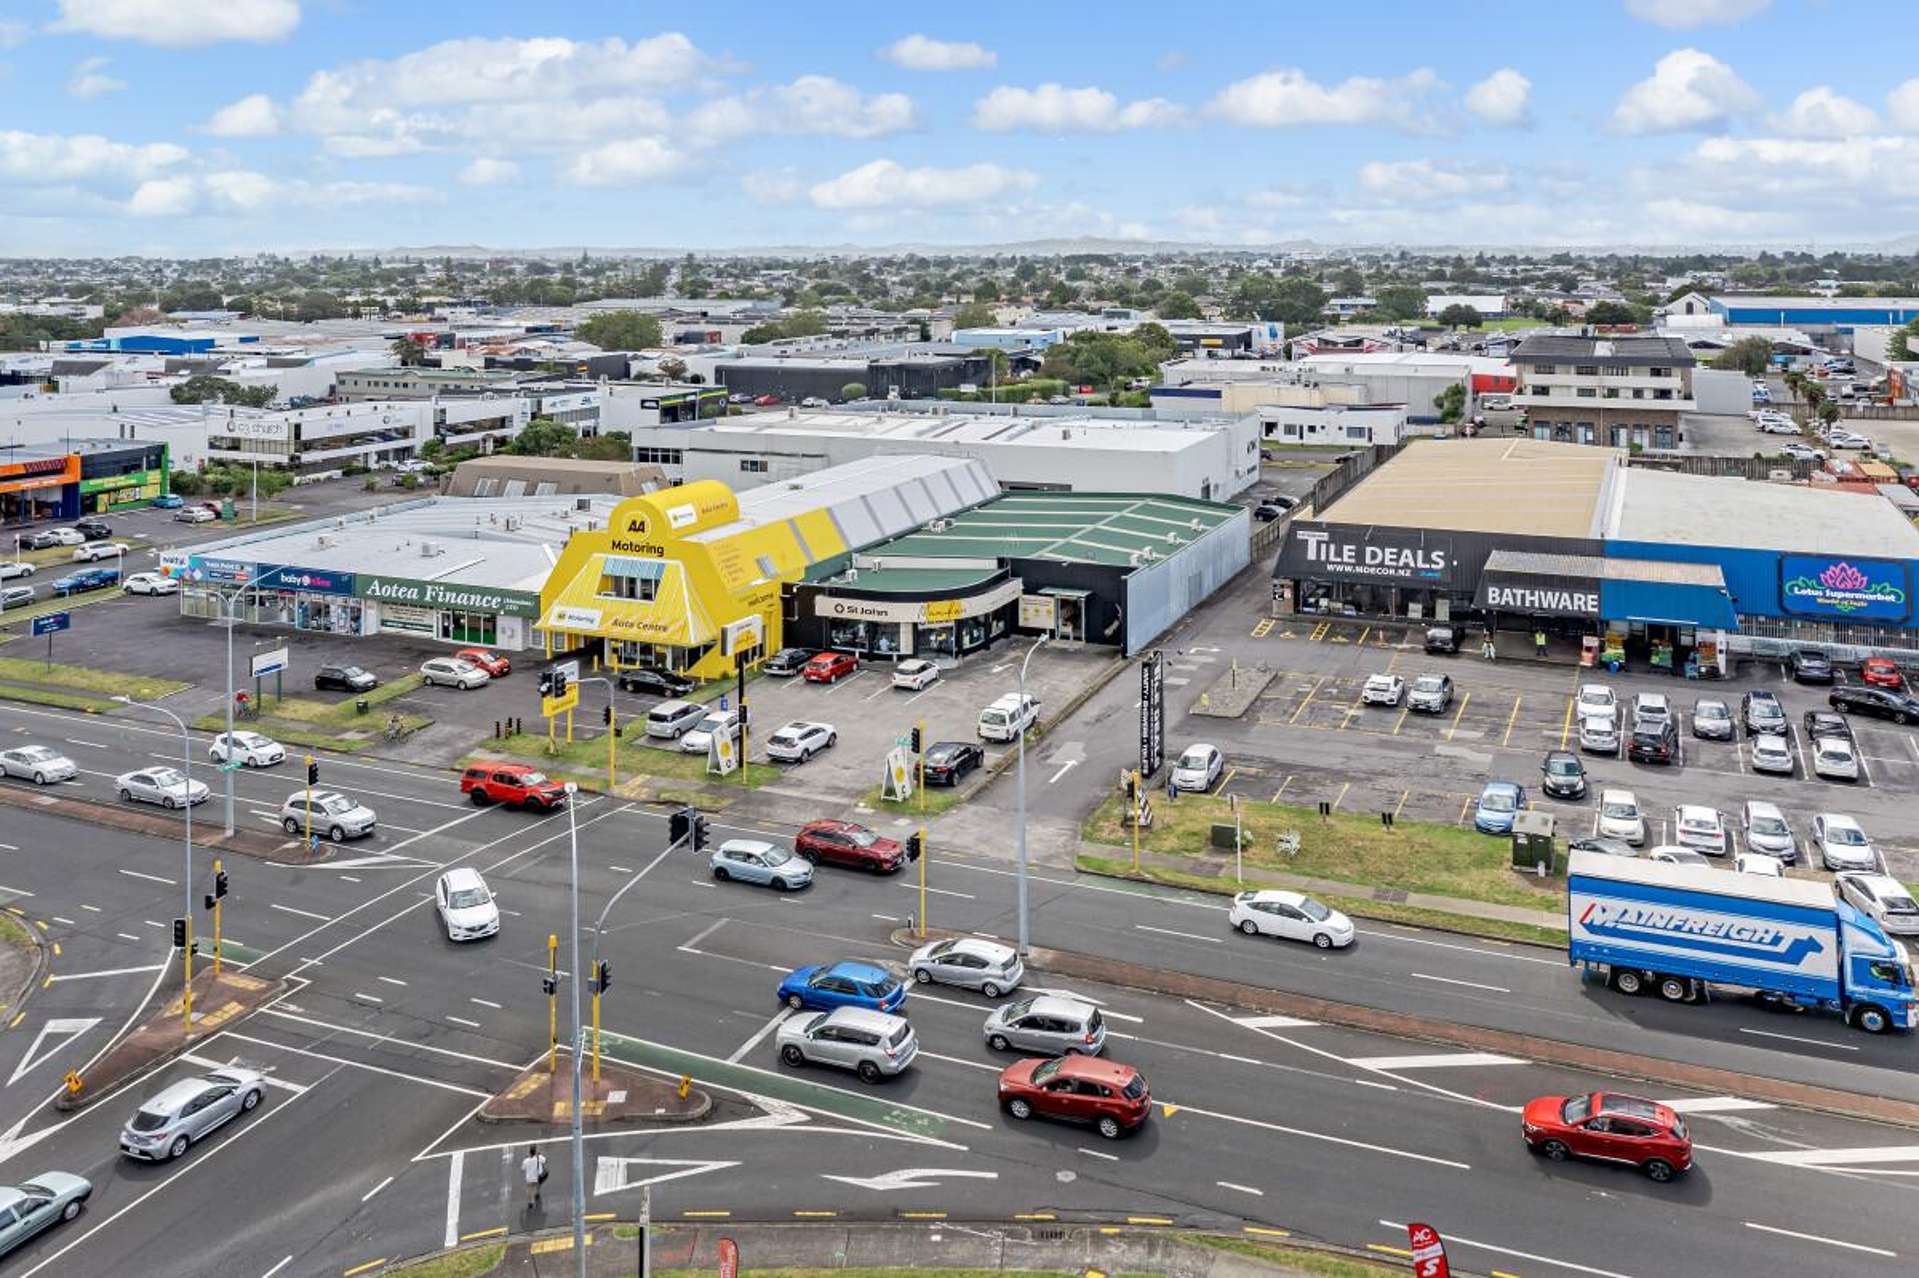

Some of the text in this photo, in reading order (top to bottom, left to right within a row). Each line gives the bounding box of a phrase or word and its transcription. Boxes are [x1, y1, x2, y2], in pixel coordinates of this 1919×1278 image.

[627, 519, 646, 533] AA
[611, 540, 665, 557] Motoring
[1296, 530, 1446, 570] TILE DEALS
[281, 573, 301, 586] baby
[366, 578, 501, 609] Aotea Finance
[1487, 587, 1599, 612] BATHWARE
[1794, 587, 1823, 597] Lotus
[846, 605, 889, 617] St John
[611, 617, 668, 633] Auto Centre
[1580, 902, 1797, 948] MAINFREIGHT
